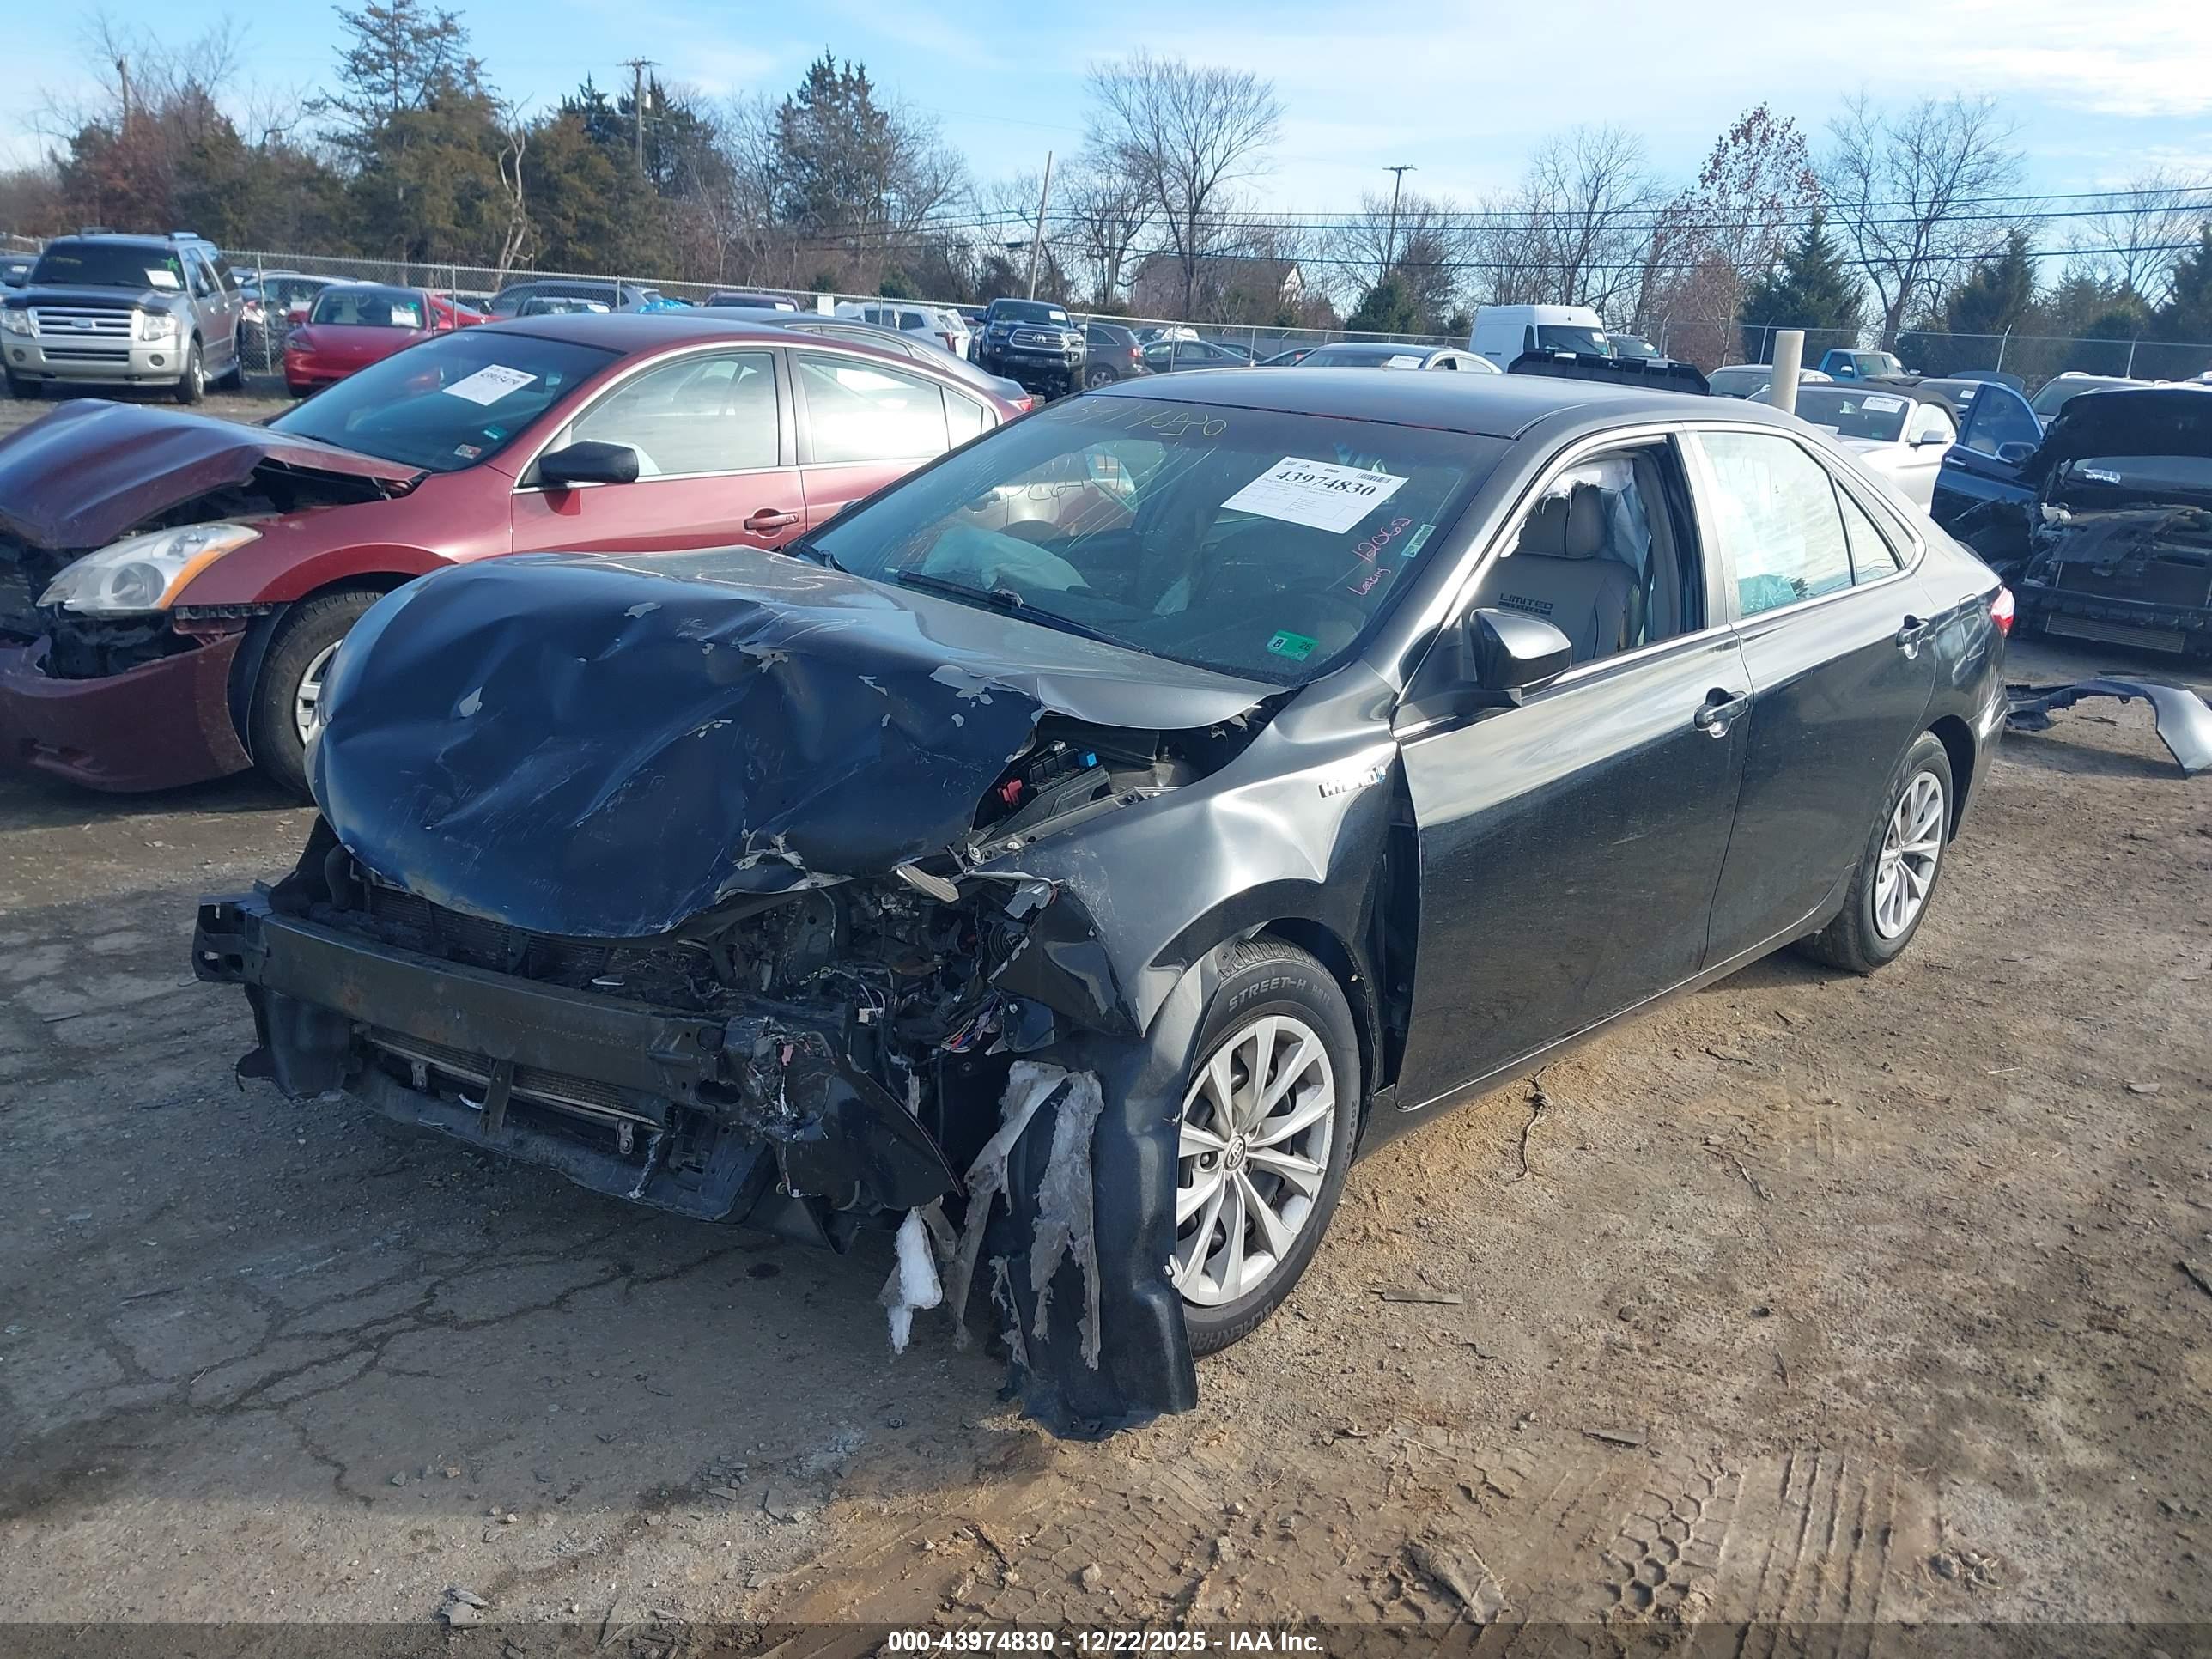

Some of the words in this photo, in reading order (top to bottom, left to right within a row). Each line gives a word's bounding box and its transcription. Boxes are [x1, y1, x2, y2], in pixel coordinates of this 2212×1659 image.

[1276, 471, 1377, 496] 43974830
[1499, 593, 1553, 610] LIMITED
[1273, 638, 1284, 648] 8
[1228, 976, 1307, 1012] STREET-H
